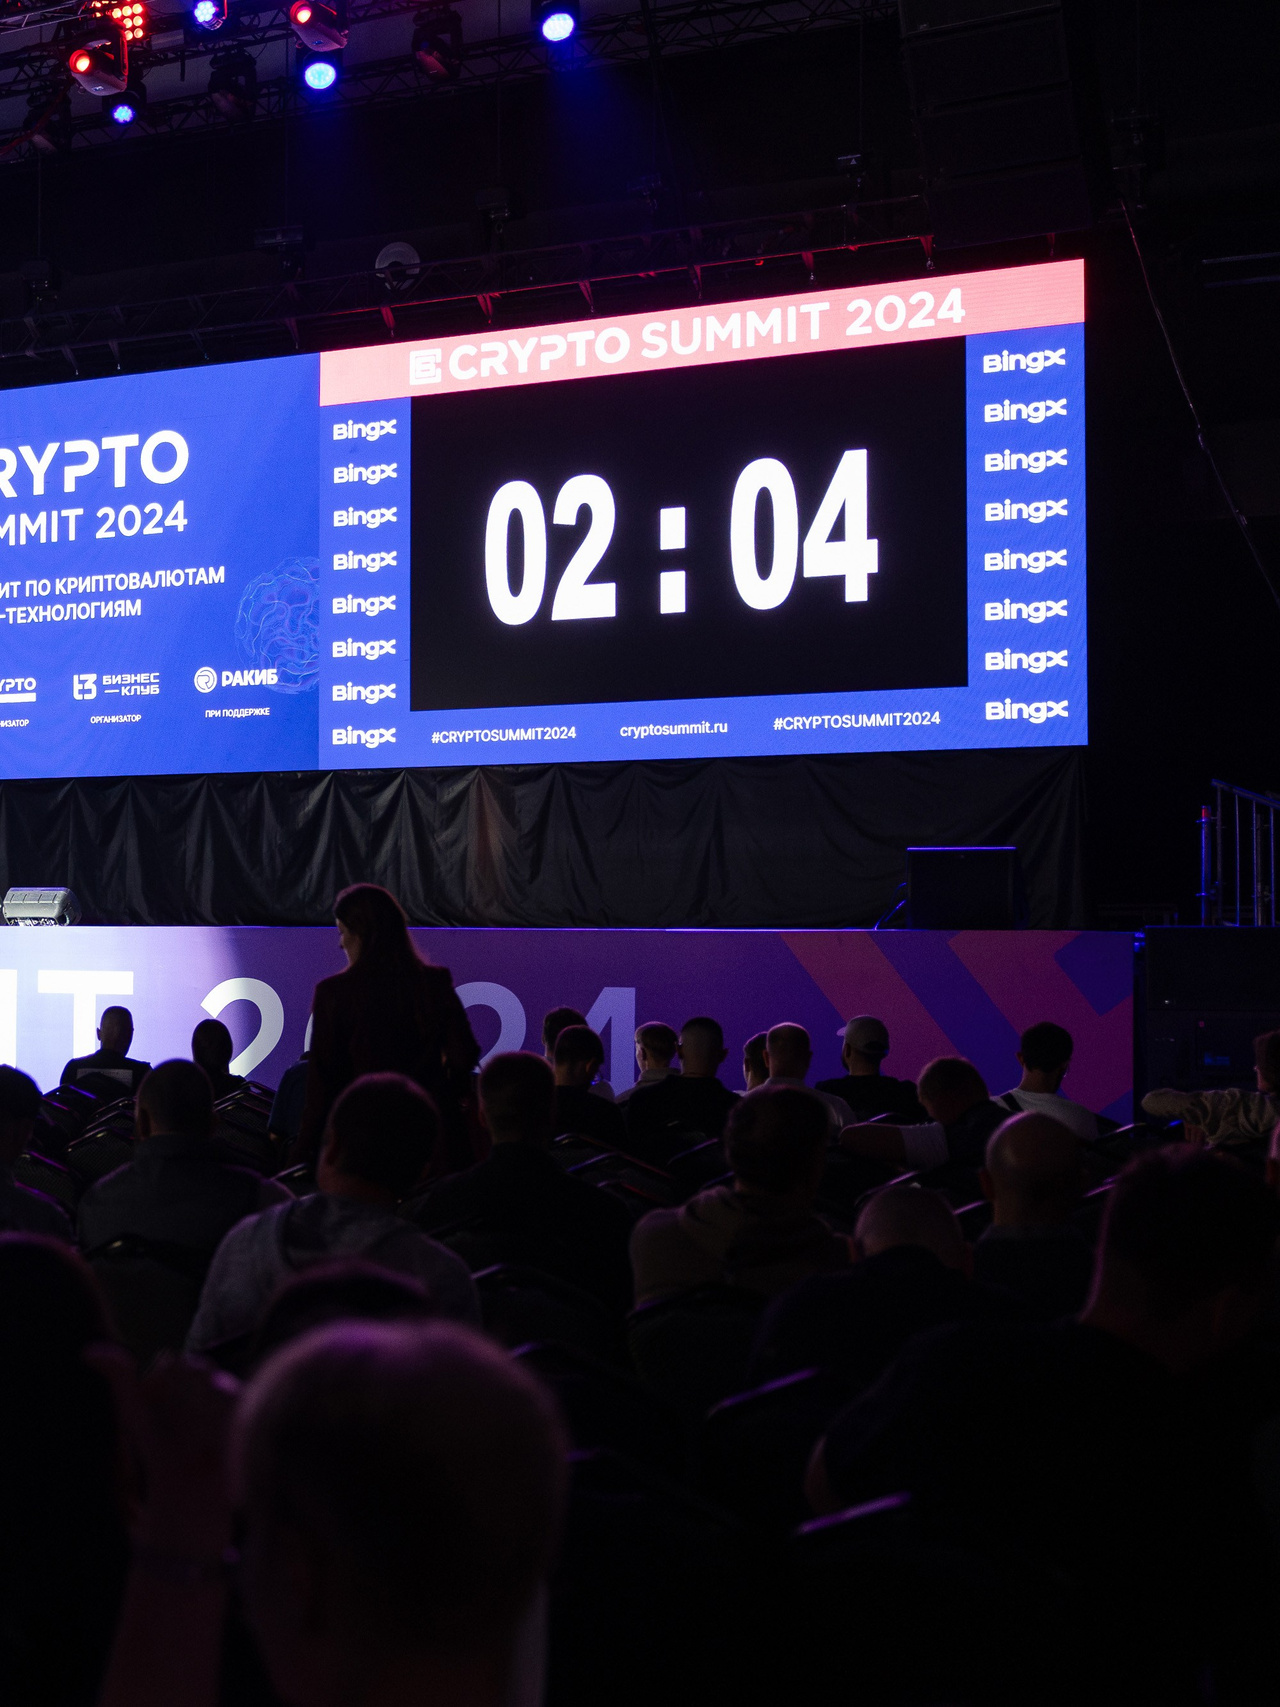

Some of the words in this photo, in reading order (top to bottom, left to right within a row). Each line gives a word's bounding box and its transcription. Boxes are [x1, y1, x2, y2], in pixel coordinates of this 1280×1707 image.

[448, 326, 631, 380] CRYPTO
[641, 301, 830, 359] SUMMIT
[845, 287, 966, 336] 2024
[95, 499, 188, 539] 2024
[484, 474, 617, 626] 02
[730, 448, 879, 611] 04
[25, 578, 51, 598] ПО
[55, 565, 225, 595] КРИПТОВАЛЮТАМ
[102, 672, 160, 684] БИЗНЕС
[221, 668, 279, 687] РАКИБ
[90, 714, 142, 724] ОРГАНИЗАТОР
[204, 709, 222, 718] ПРИ
[222, 707, 271, 719] ПОДДЕРЖКЕ
[430, 725, 577, 744] #CRYPTOSUMMIT2024
[619, 720, 728, 740] cryptosummit.ru
[772, 710, 941, 731] #CRYPTOSUMMIT2024
[199, 977, 637, 1100] 224
